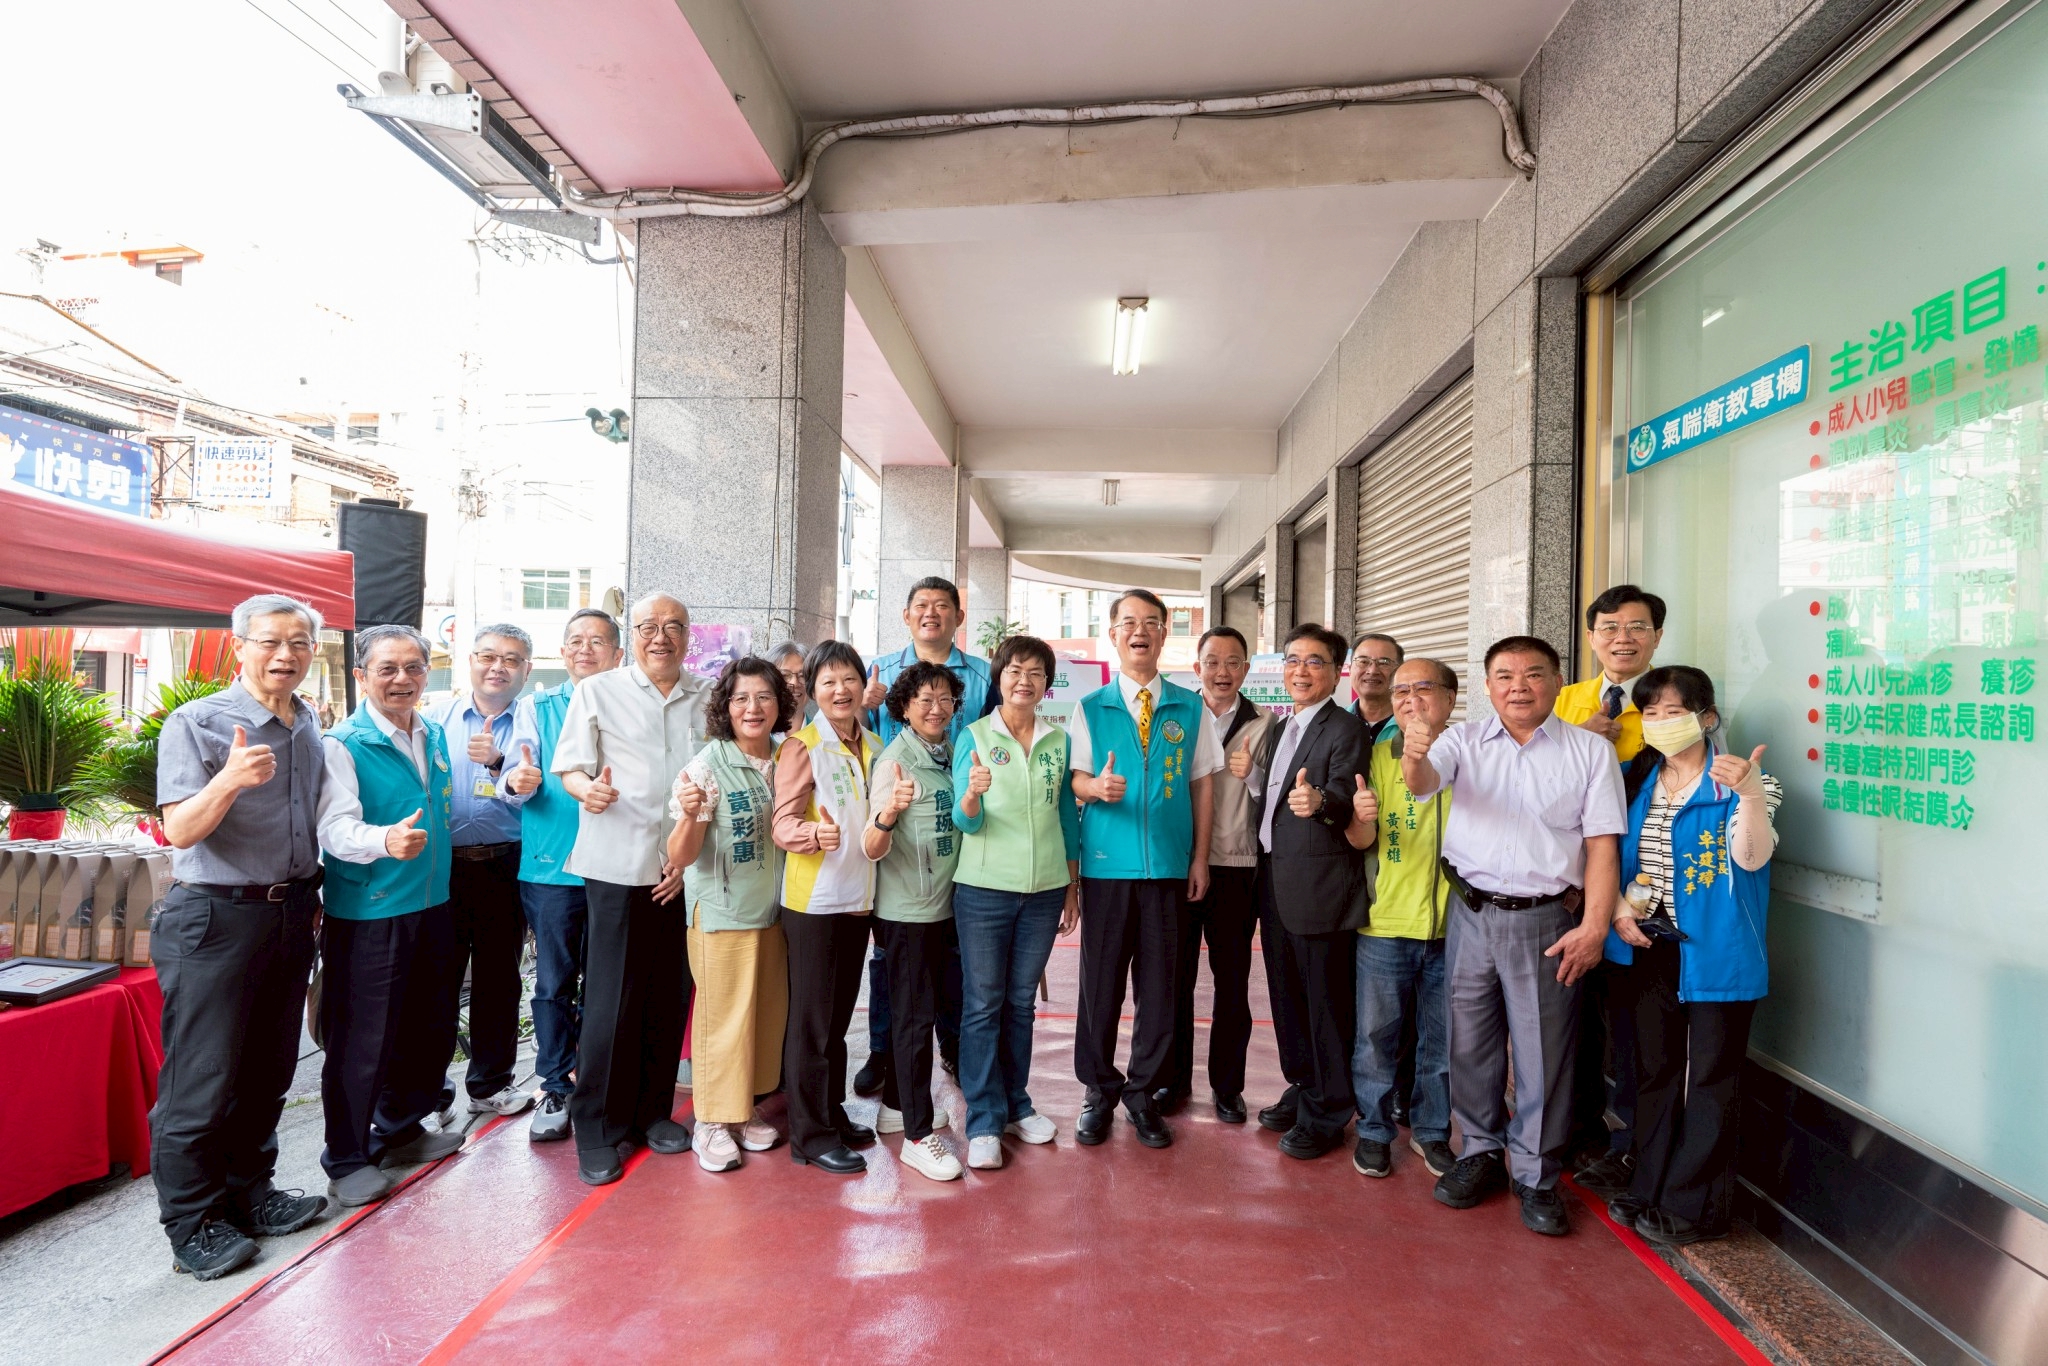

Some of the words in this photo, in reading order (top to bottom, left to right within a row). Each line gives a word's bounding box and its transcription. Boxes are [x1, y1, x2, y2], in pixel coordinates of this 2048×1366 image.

[1661, 359, 1803, 450] 氣喘衛教專欄
[35, 447, 131, 506] 快剪
[1824, 701, 2036, 744] 青少年保健成長諮詢
[1038, 752, 1056, 805] 陳素月
[1823, 741, 1976, 786] 青春痘特別門診
[727, 790, 756, 864] 黃彩惠
[1386, 812, 1402, 864] 黃重雄
